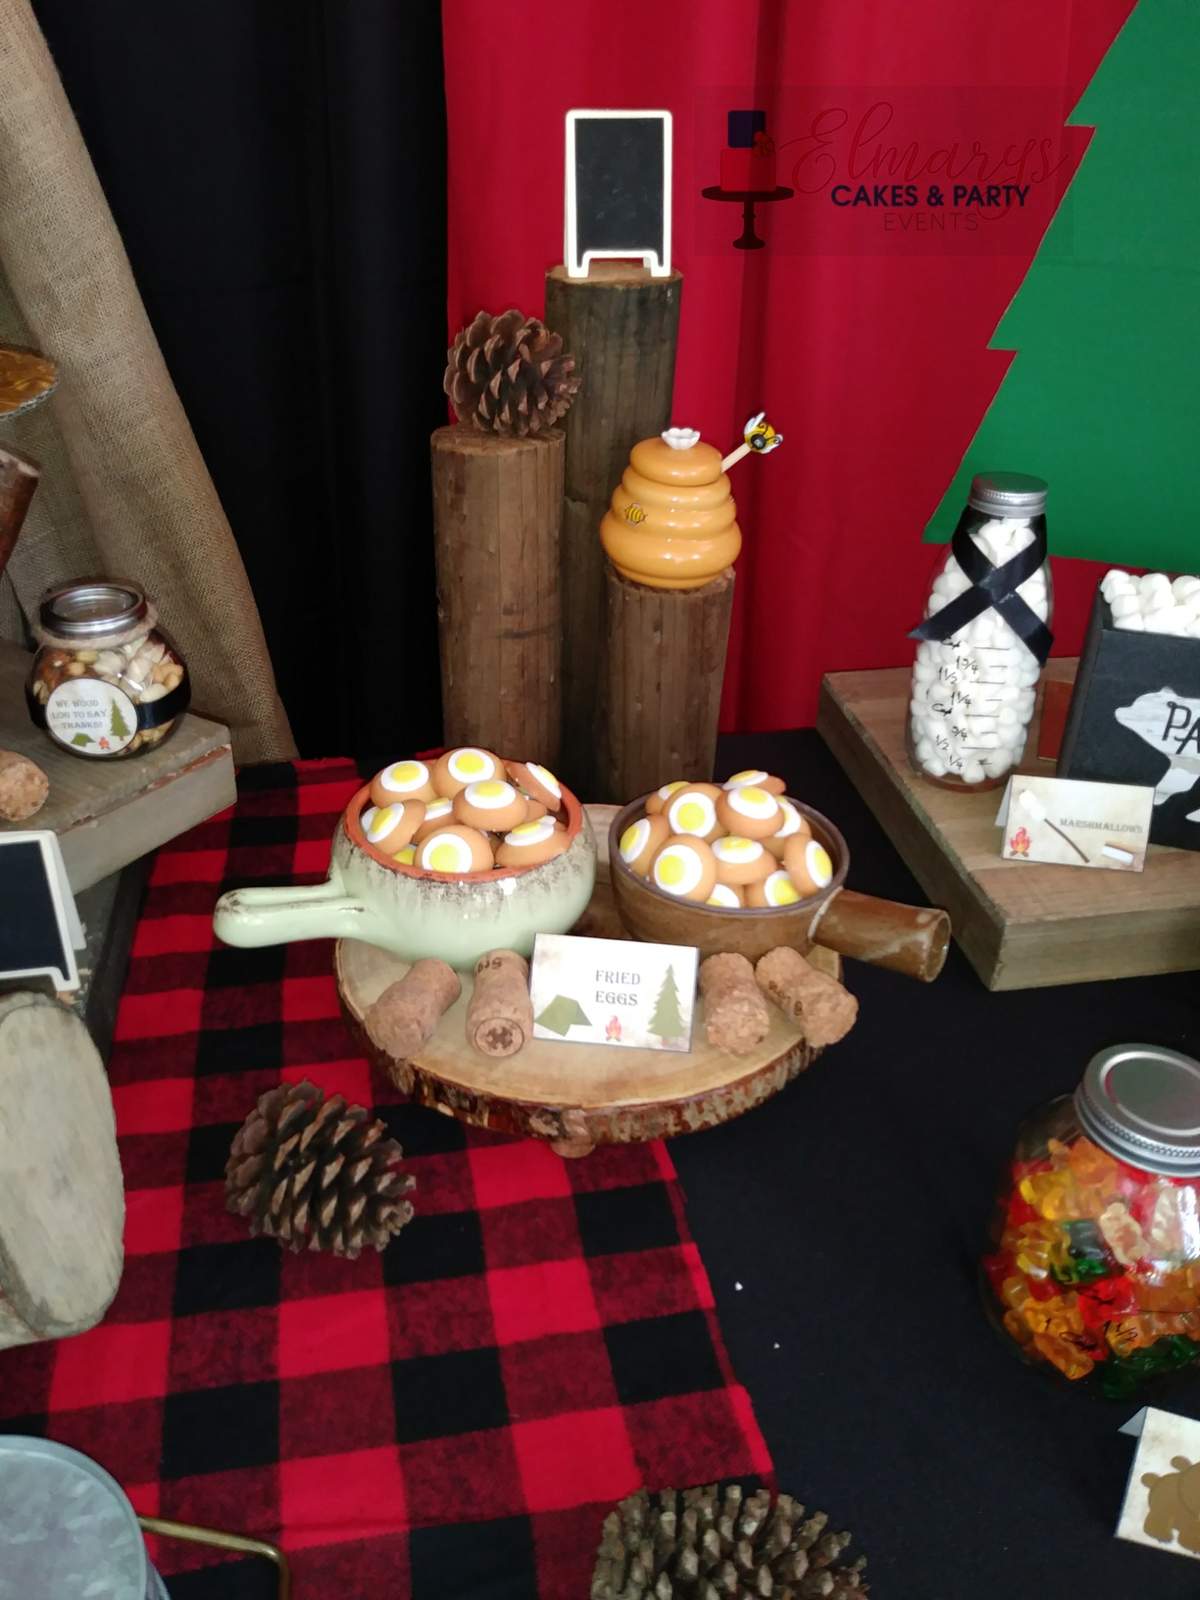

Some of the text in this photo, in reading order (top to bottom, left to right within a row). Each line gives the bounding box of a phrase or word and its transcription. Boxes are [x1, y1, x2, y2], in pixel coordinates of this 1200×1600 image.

[73, 711, 85, 719] TO
[86, 709, 107, 719] SAY
[1059, 818, 1144, 834] MARSHMALLOWS
[595, 969, 641, 986] FRIED
[595, 990, 639, 1007] EGGS
